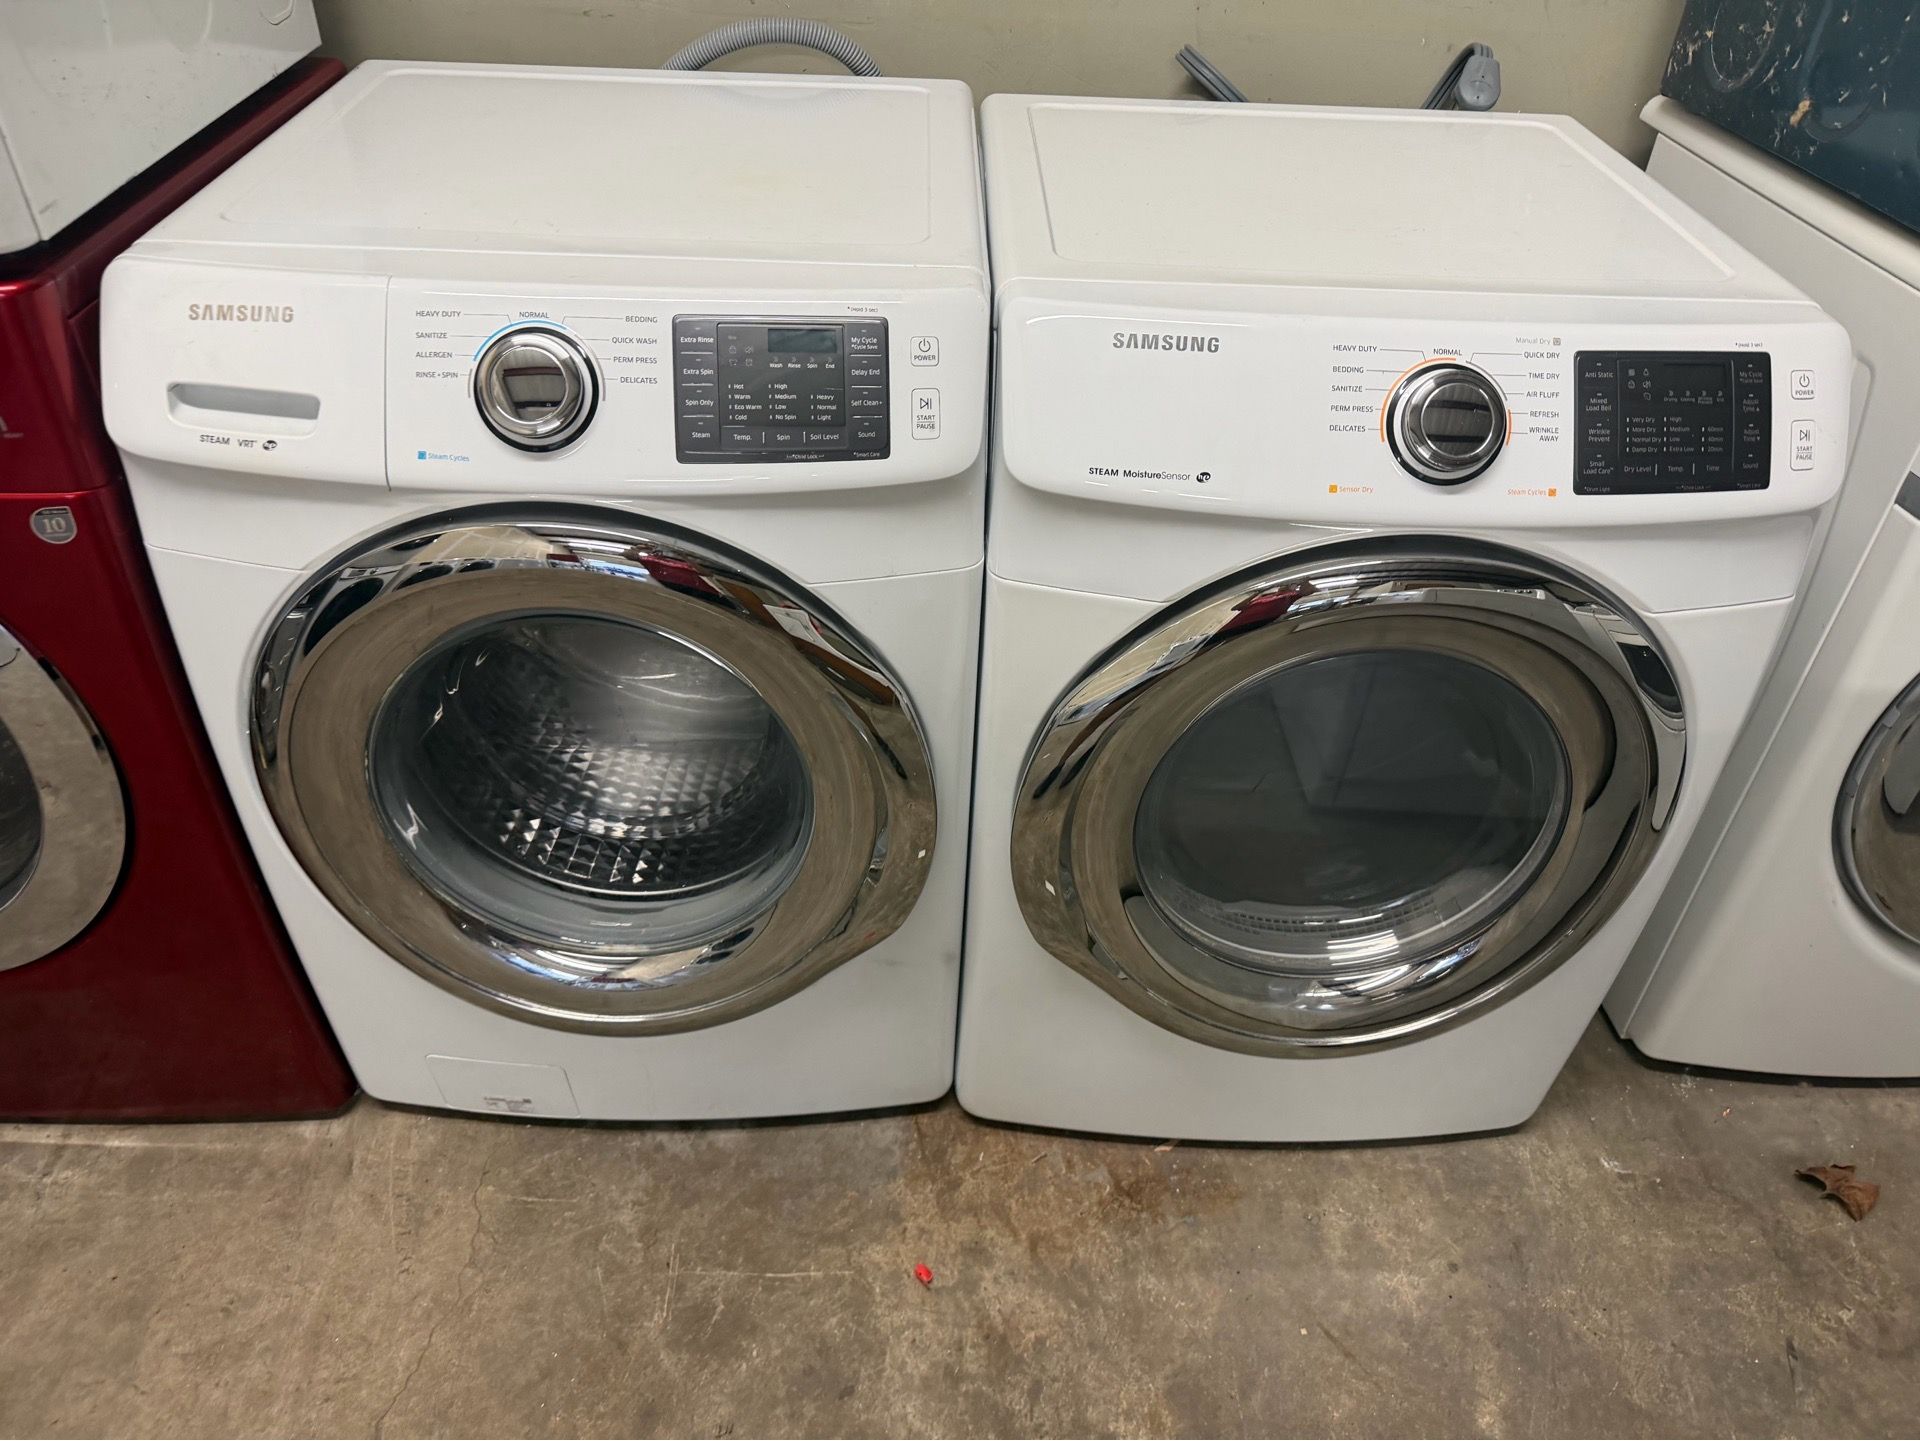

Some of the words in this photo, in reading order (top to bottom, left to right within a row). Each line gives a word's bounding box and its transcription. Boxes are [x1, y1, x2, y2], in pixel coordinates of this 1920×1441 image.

[188, 303, 294, 323] SAMSUNG
[519, 311, 549, 319] NORMAL
[625, 315, 657, 323] BEDDING
[1112, 332, 1220, 353] SAMSUNG
[1333, 344, 1357, 352] HEAVY
[1433, 348, 1462, 356] NORMAL
[1523, 351, 1545, 359] QUICK
[620, 376, 657, 384] DELICATES
[700, 399, 714, 407] Only
[1330, 404, 1350, 412] PERM
[1329, 424, 1366, 432] DELICATES
[199, 434, 230, 446] STEAM
[449, 454, 470, 462] Cycles
[1088, 467, 1119, 477] STEAM
[1624, 465, 1634, 473] Dry
[1361, 486, 1373, 494] Dry
[1527, 489, 1547, 497] Cycles
[42, 517, 66, 533] 10
